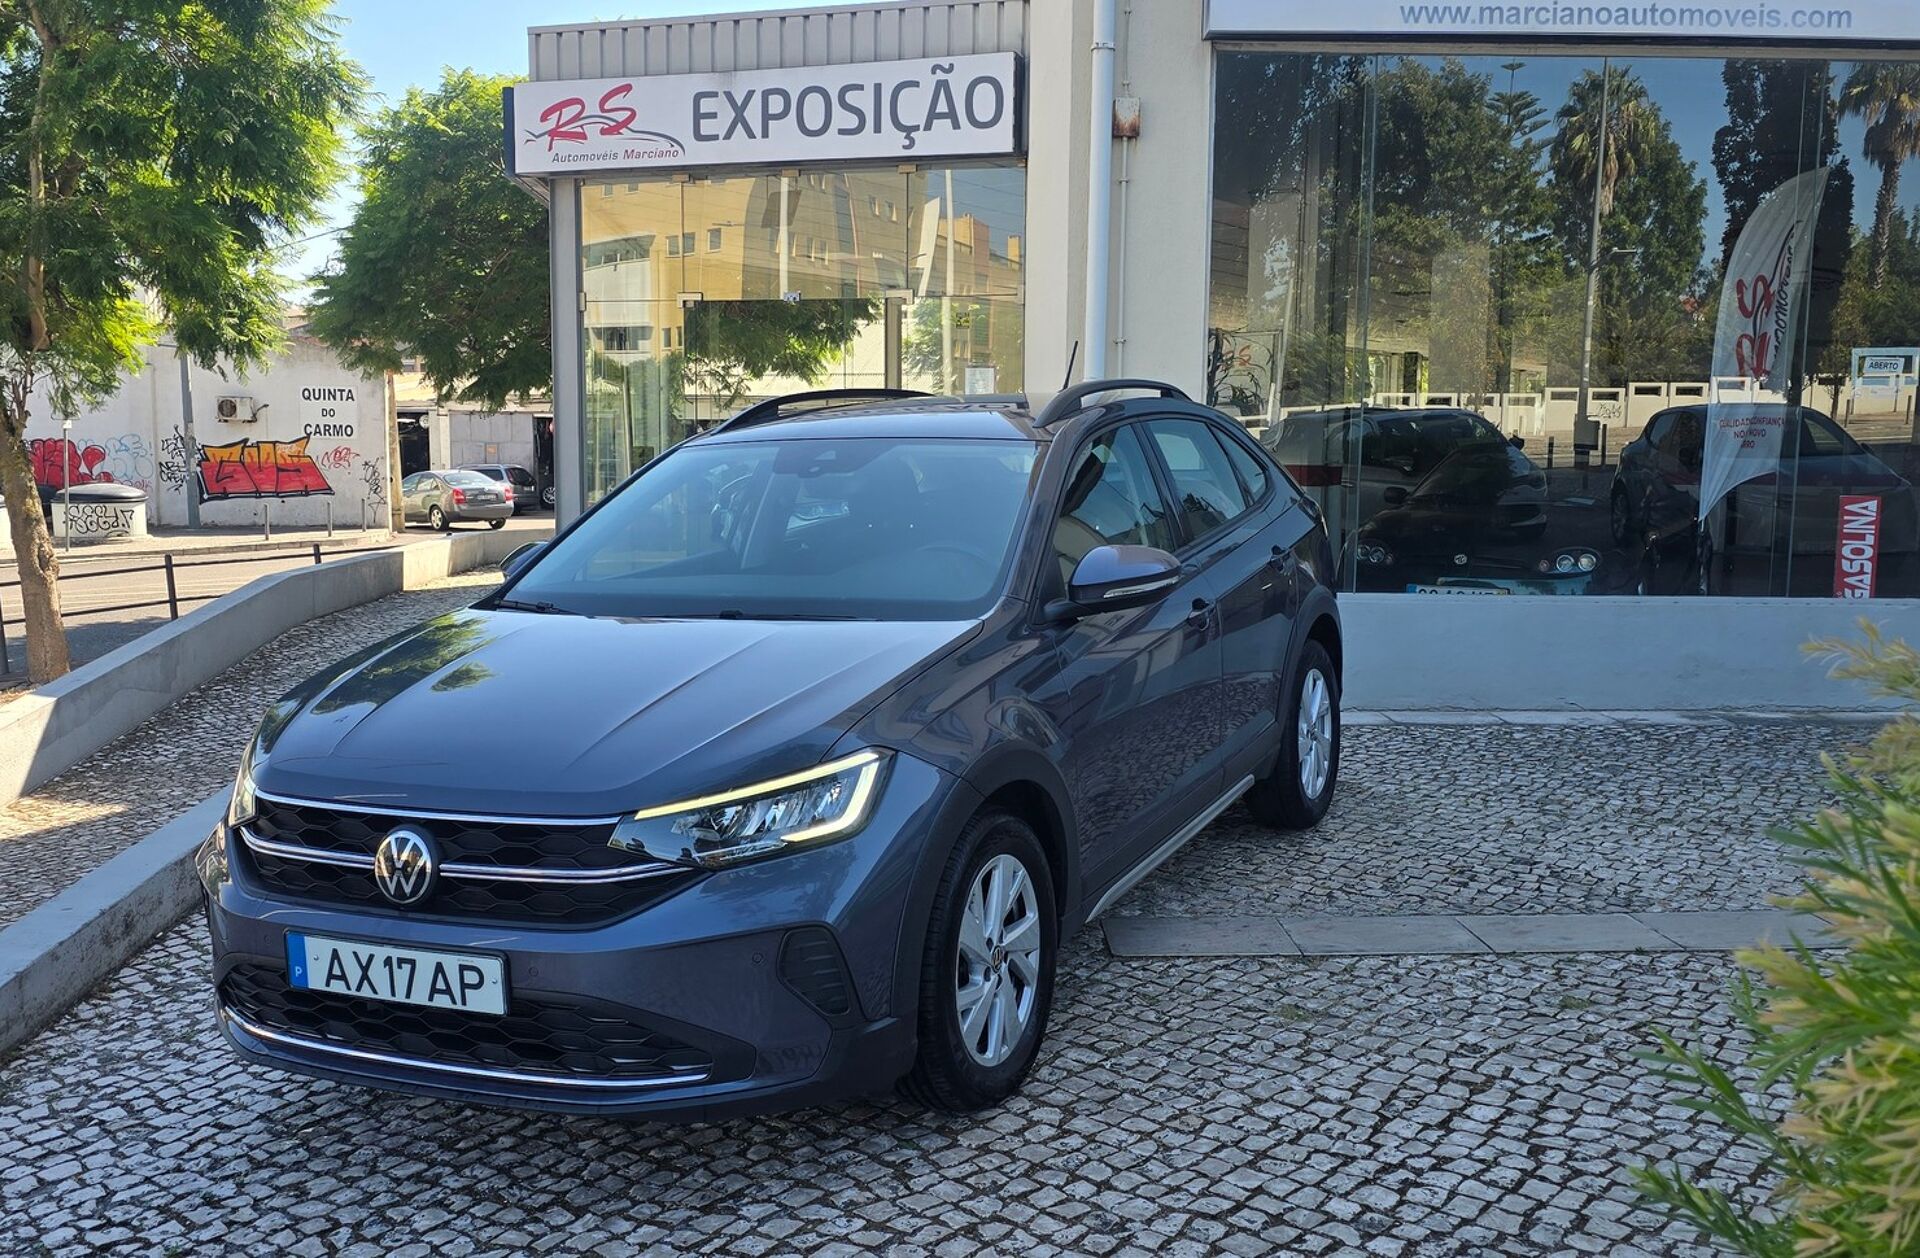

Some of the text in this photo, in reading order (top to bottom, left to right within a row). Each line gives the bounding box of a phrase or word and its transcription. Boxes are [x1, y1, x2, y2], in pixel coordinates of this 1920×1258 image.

[1401, 2, 1852, 28] www.marcianoautomoveis.com
[692, 62, 1005, 150] EXPOSIÇÃO
[540, 83, 637, 152] RS
[623, 148, 679, 161] Marciano
[1868, 361, 1899, 370] ABERTO
[302, 388, 355, 401] QUINTA
[321, 408, 336, 417] DO
[304, 424, 354, 437] CARMO
[295, 965, 303, 978] P
